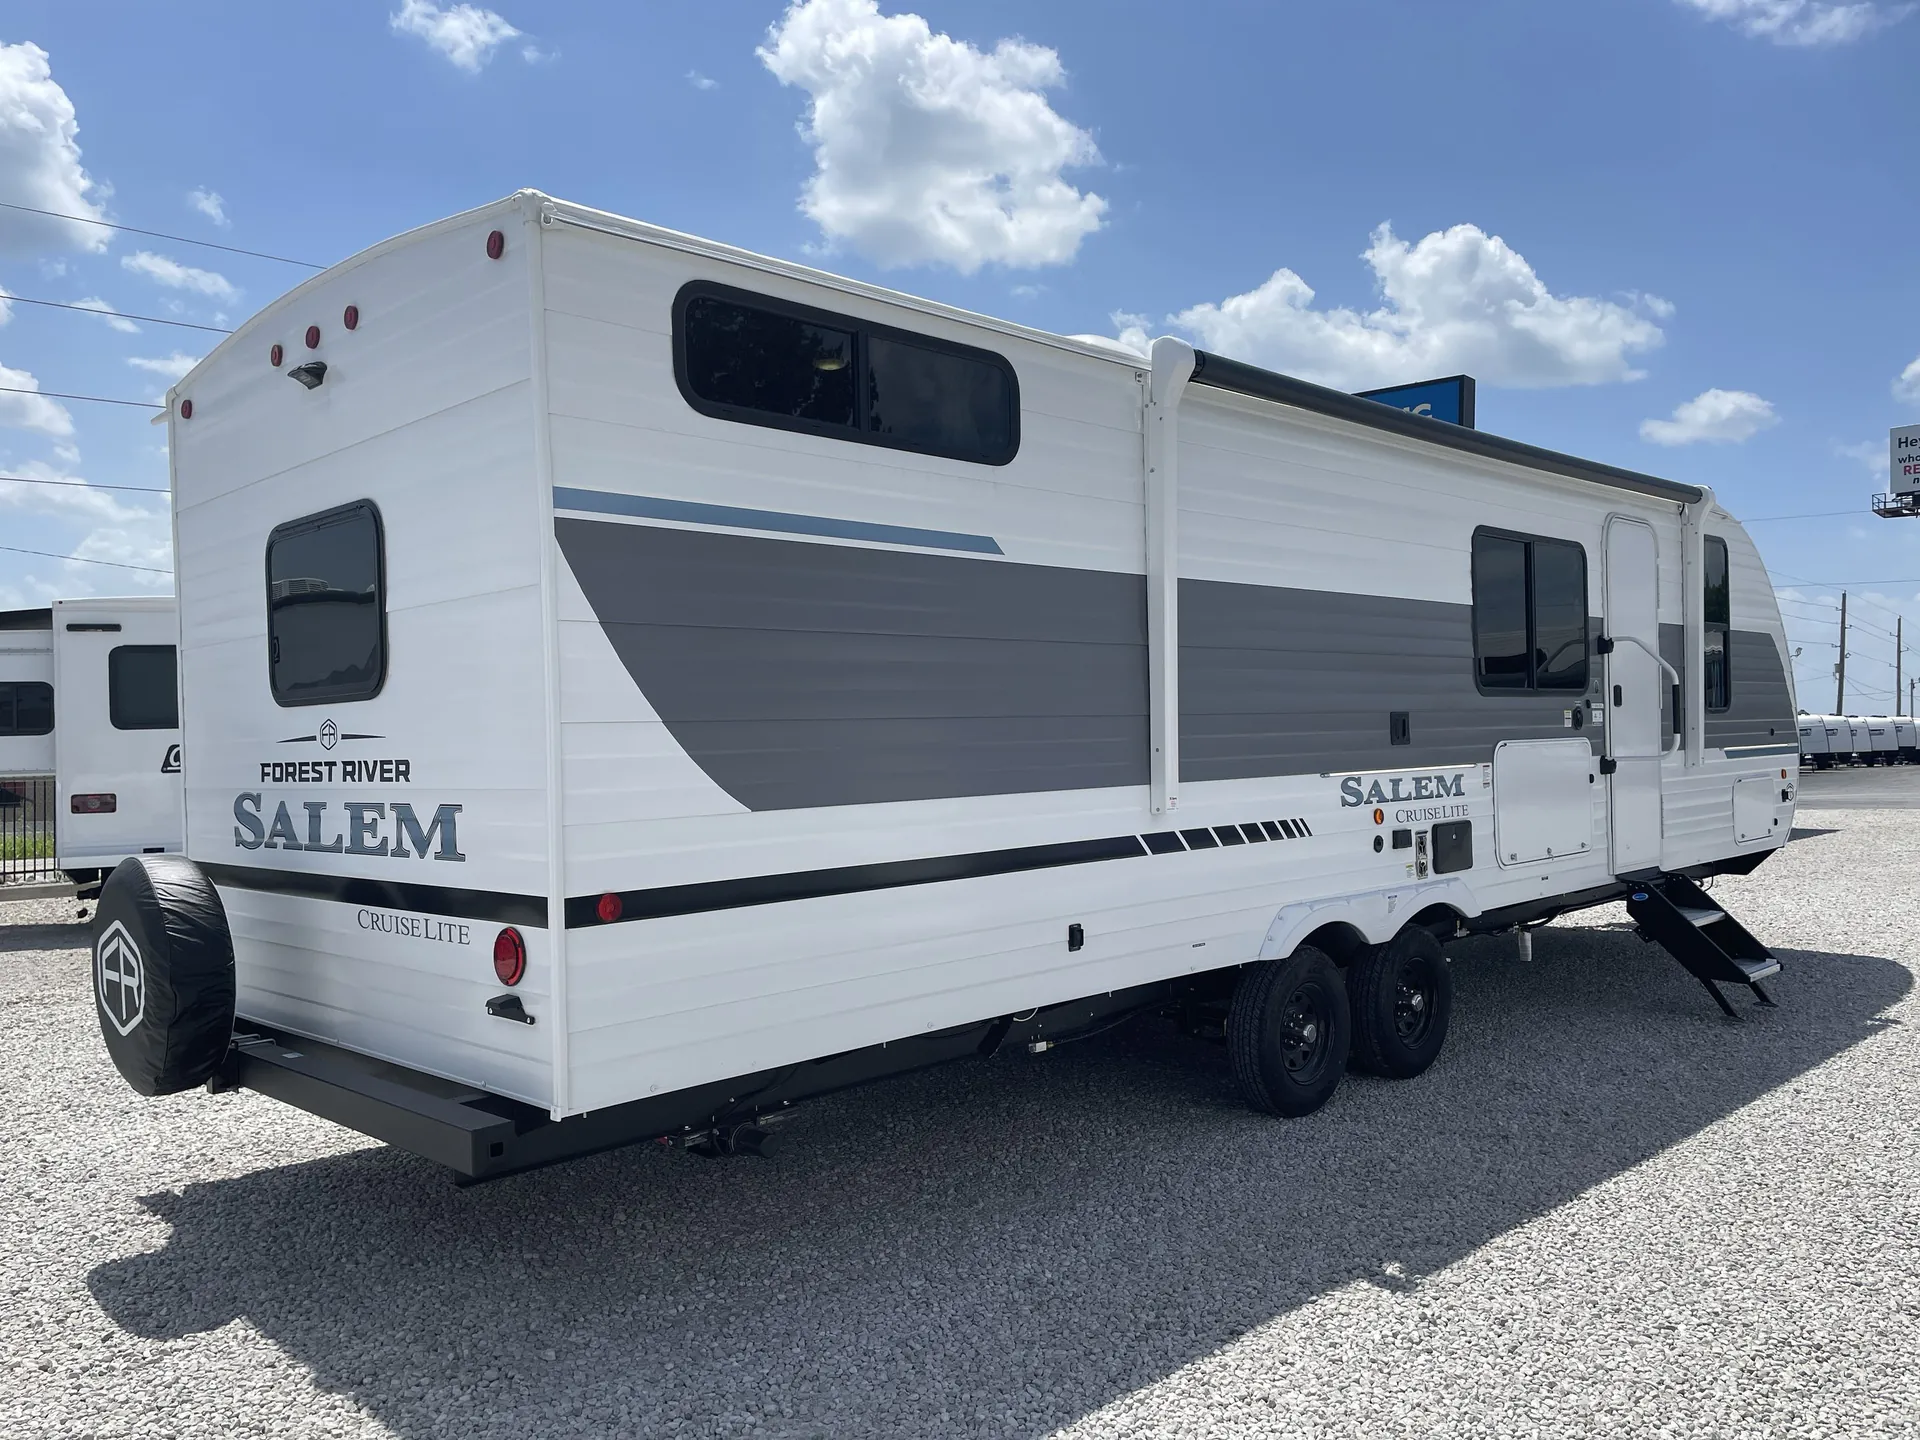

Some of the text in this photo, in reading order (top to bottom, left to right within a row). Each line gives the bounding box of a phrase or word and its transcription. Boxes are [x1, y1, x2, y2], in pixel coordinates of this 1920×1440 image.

[1898, 437, 1920, 449] He
[260, 759, 411, 783] FOREST RIVER
[1340, 773, 1466, 807] SALEM
[233, 791, 466, 862] SALEM
